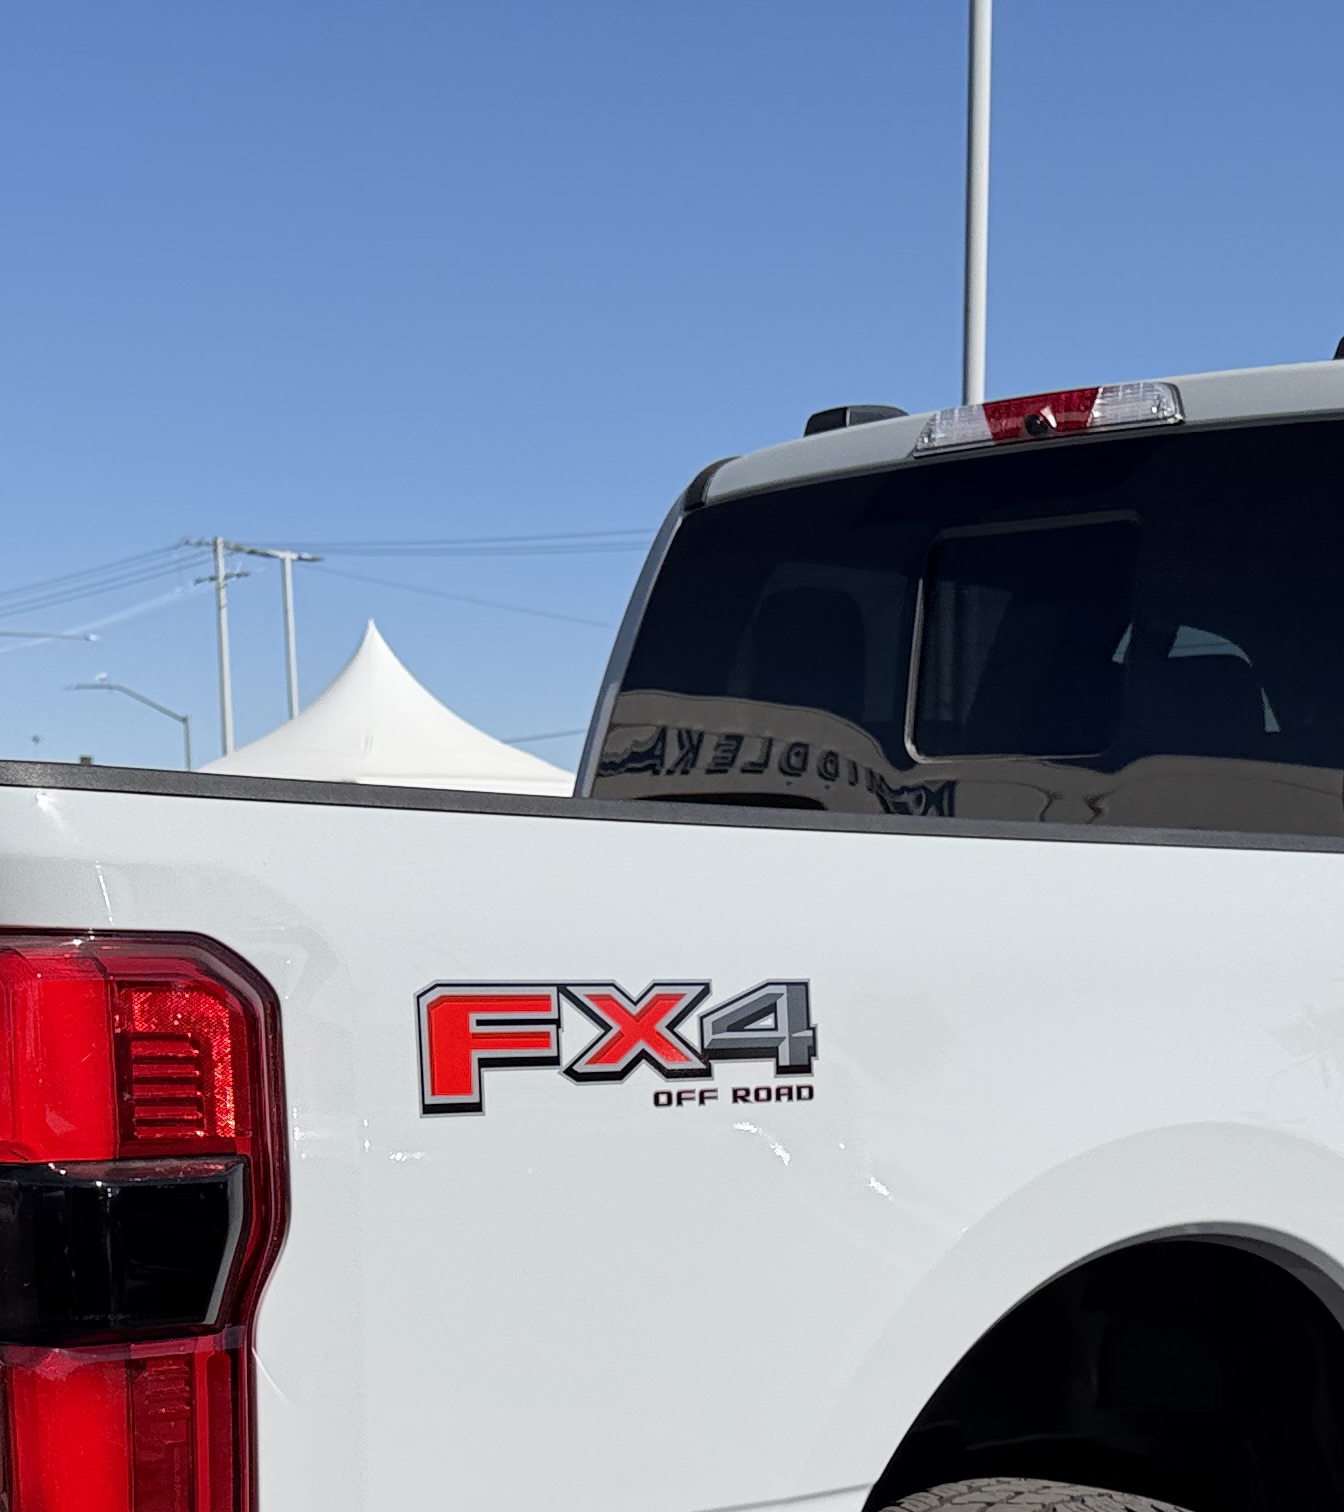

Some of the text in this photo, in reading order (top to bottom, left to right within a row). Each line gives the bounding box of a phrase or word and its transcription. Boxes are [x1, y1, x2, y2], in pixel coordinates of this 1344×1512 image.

[414, 979, 818, 1117] FX4
[653, 1084, 814, 1107] OFF ROAD
